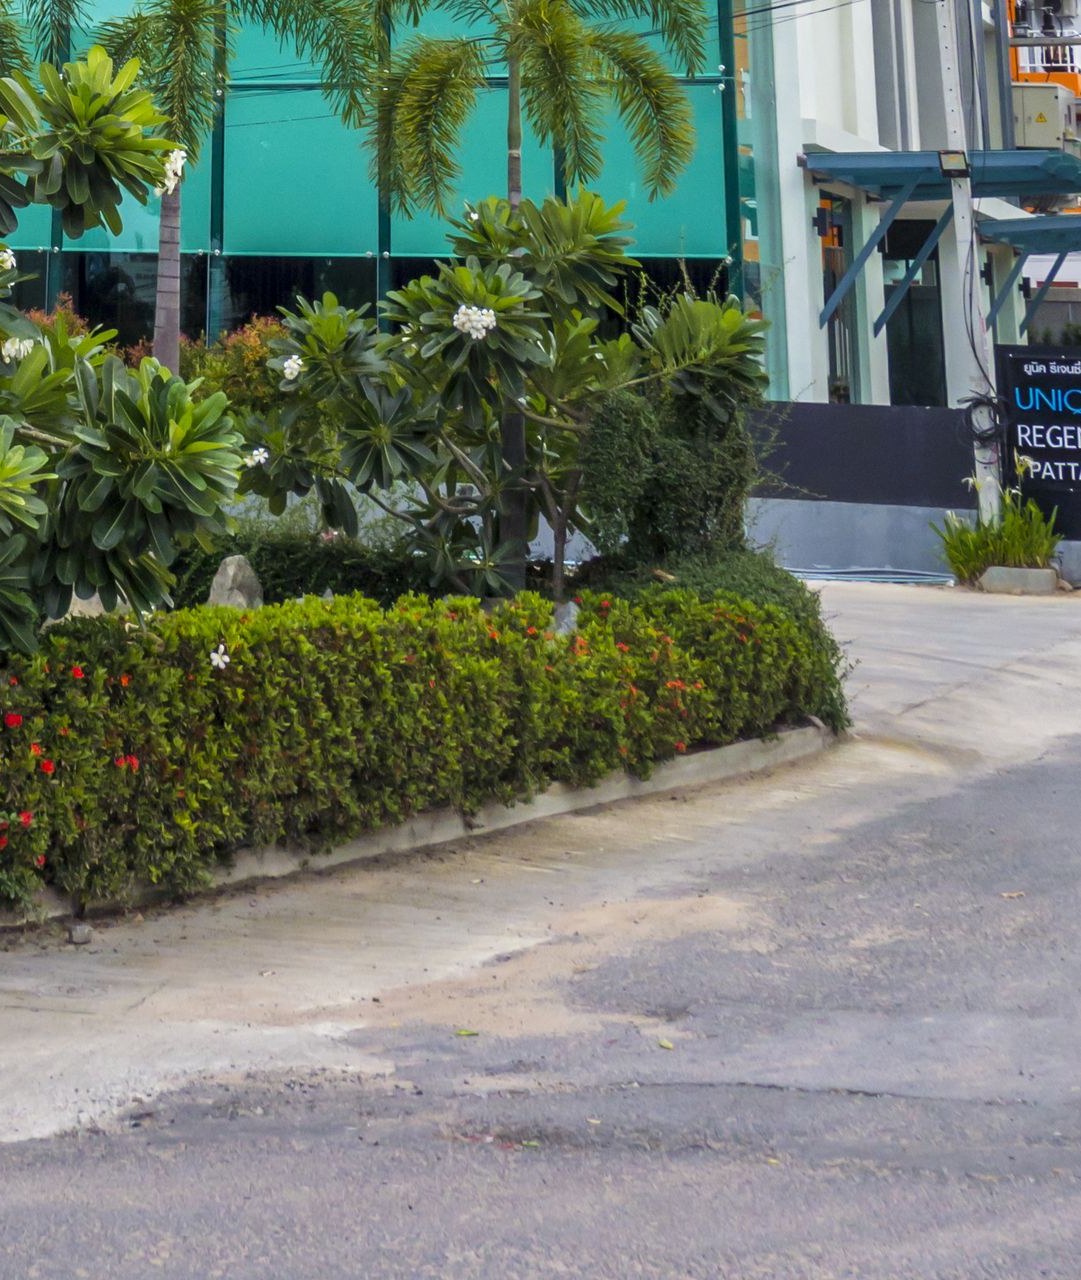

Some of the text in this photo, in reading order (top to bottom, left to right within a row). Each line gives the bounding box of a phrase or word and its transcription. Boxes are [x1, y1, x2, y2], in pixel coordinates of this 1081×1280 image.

[1015, 387, 1081, 415] UNIQ
[1017, 424, 1081, 449] REGE
[1029, 461, 1081, 481] PATT
